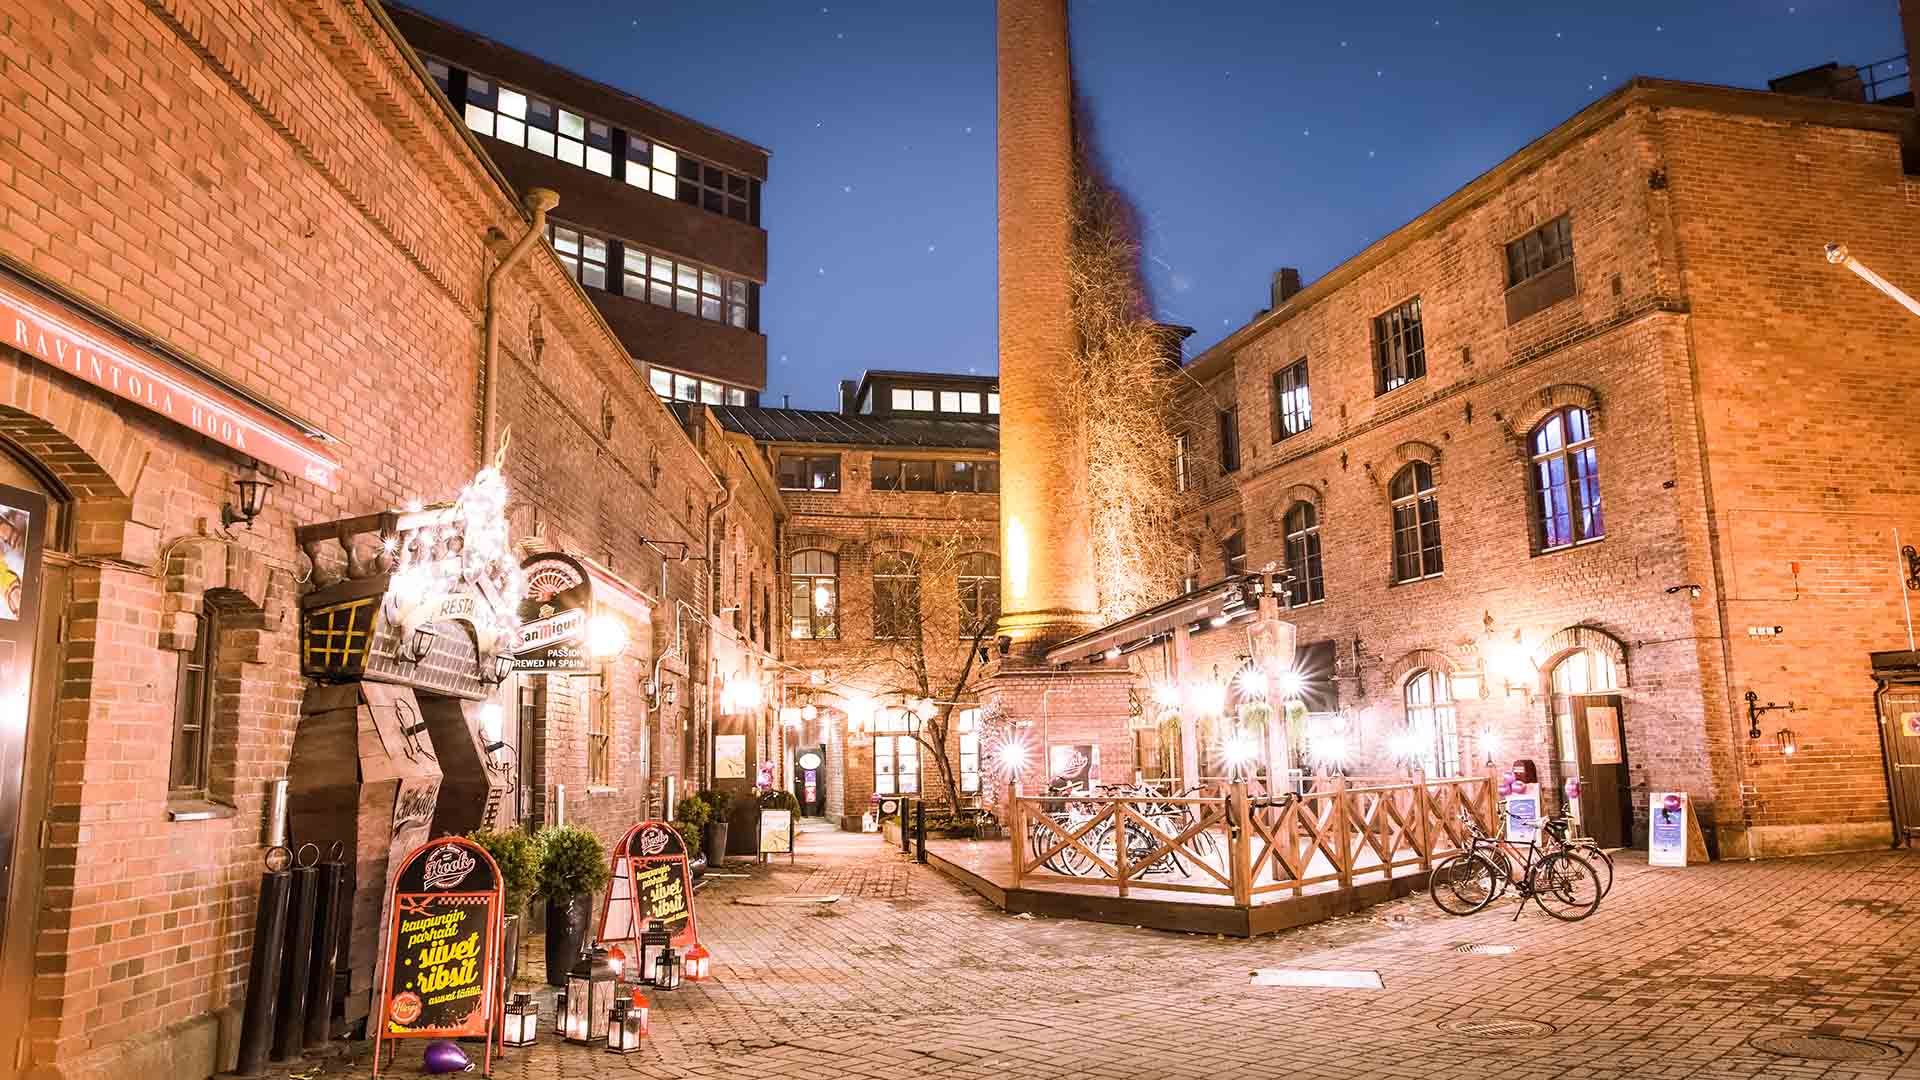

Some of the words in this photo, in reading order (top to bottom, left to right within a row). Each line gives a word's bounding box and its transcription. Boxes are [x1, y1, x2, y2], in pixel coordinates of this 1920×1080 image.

[15, 319, 173, 414] RAVINTOLA
[191, 404, 248, 449] HOOK
[440, 598, 477, 617] RESTA
[546, 660, 556, 668] IN
[424, 850, 476, 880] Hook
[650, 878, 683, 903] siivet
[652, 894, 685, 919] ribsit
[401, 908, 467, 934] kaupungin
[408, 923, 459, 949] parhaat
[418, 931, 480, 969] siivet
[417, 957, 479, 993] ribsit
